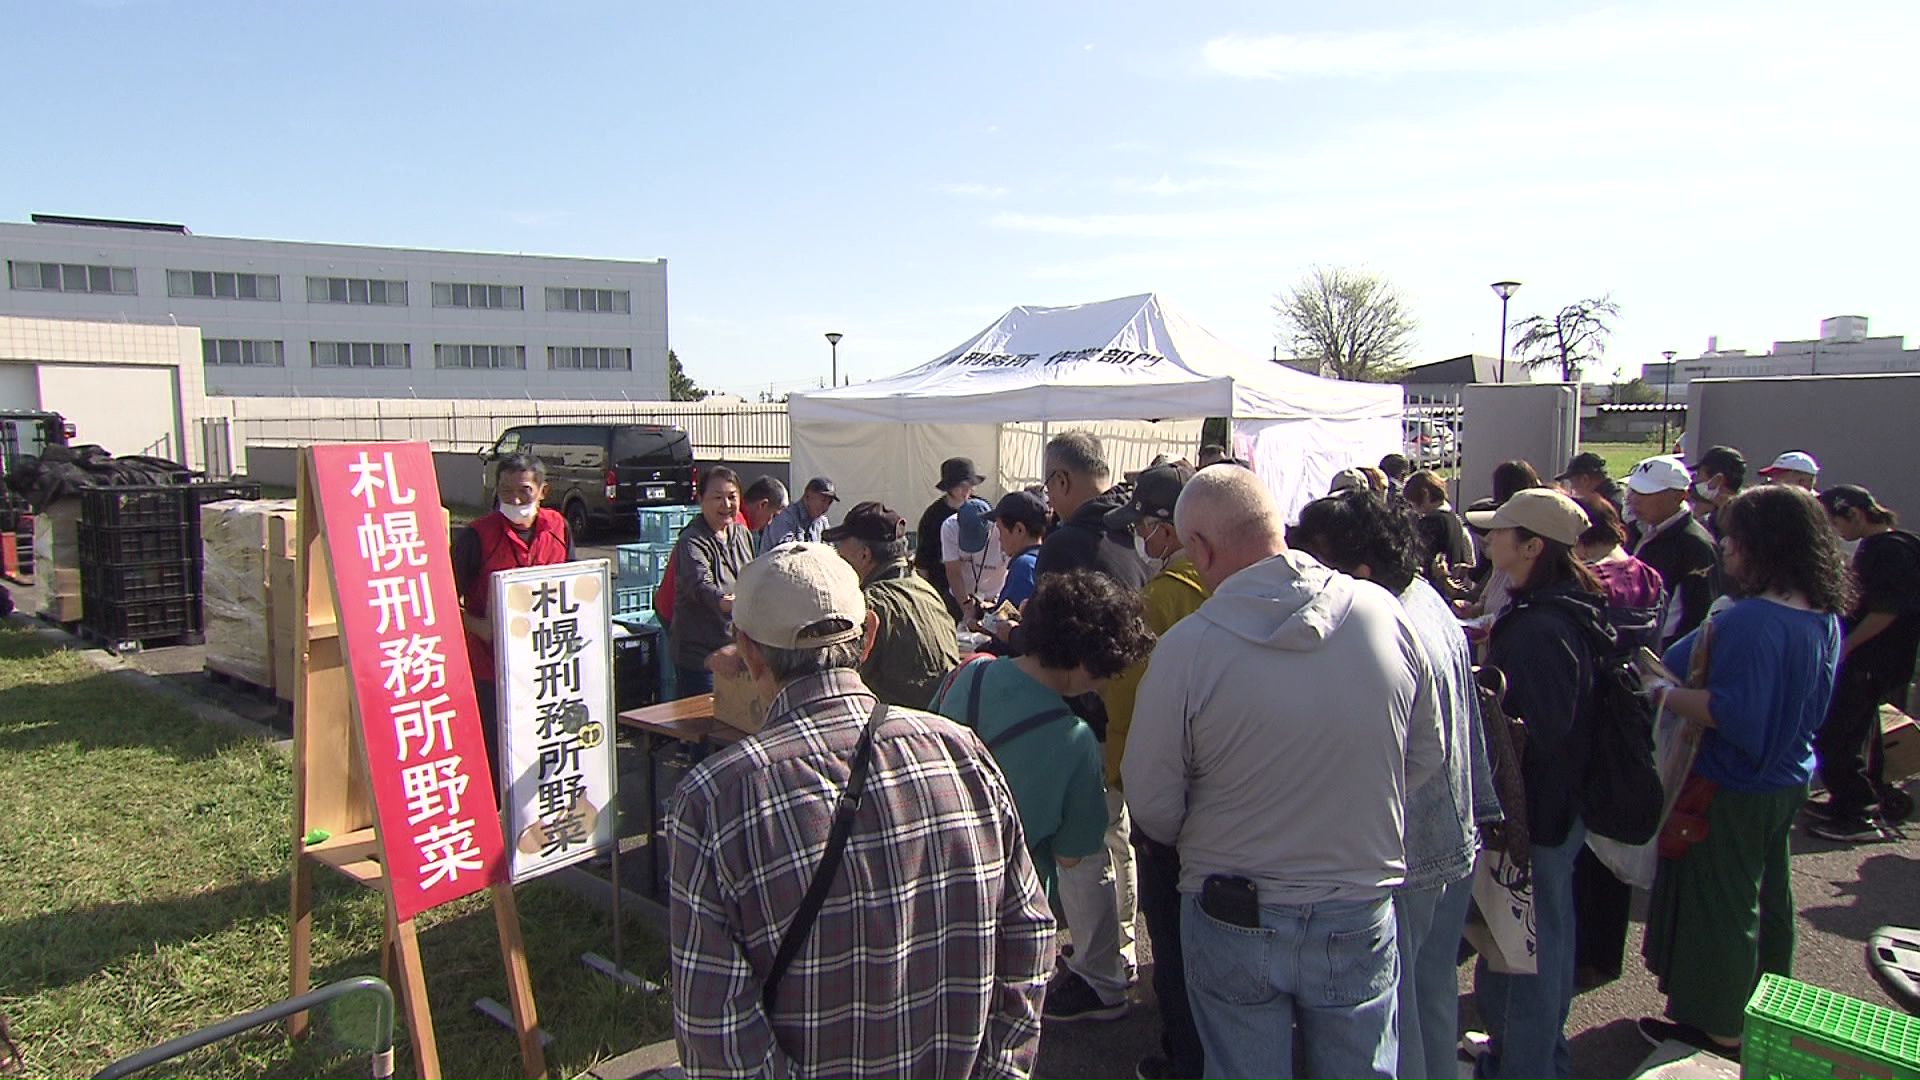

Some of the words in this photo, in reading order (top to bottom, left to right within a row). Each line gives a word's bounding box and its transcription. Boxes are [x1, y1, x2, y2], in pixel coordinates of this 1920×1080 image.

[349, 451, 484, 890] 札幌刑務所野菜
[532, 581, 587, 858] 札幌刑務所野菜
